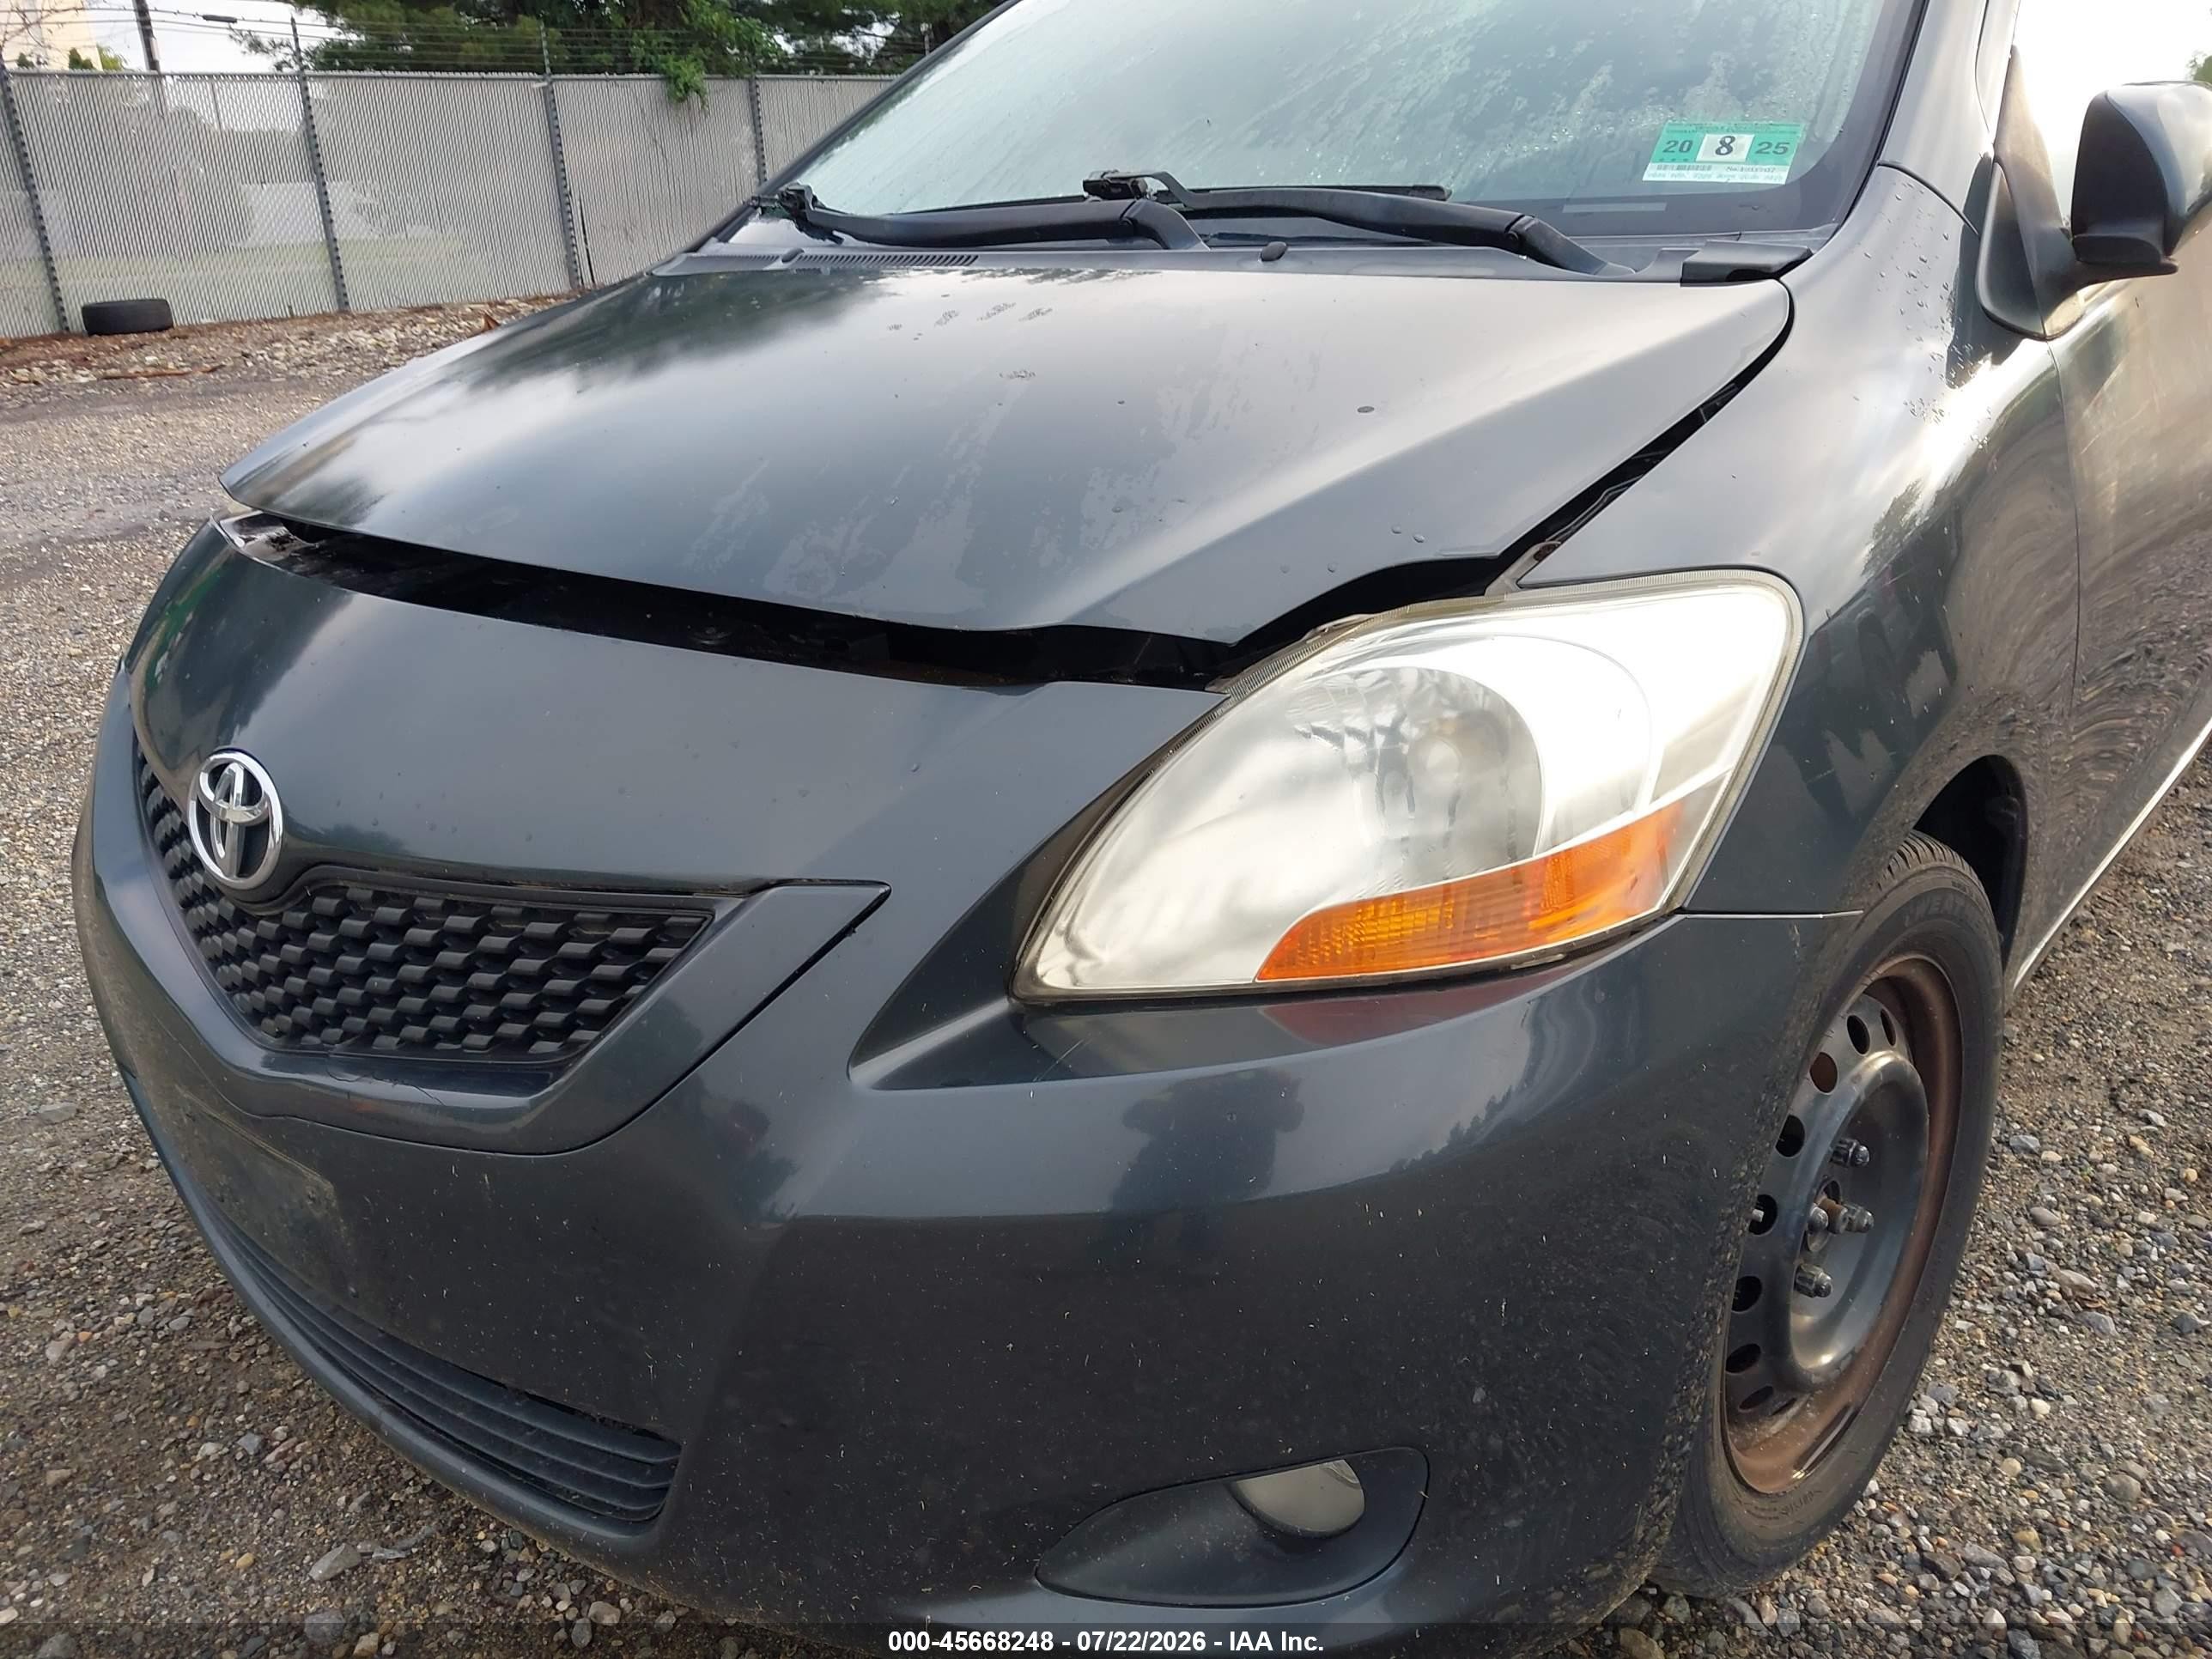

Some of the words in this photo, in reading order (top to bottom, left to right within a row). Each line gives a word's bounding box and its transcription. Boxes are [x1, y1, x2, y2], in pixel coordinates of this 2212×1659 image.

[1662, 140, 1693, 154] 20
[1715, 135, 1736, 156] 8
[1754, 141, 1790, 155] 25
